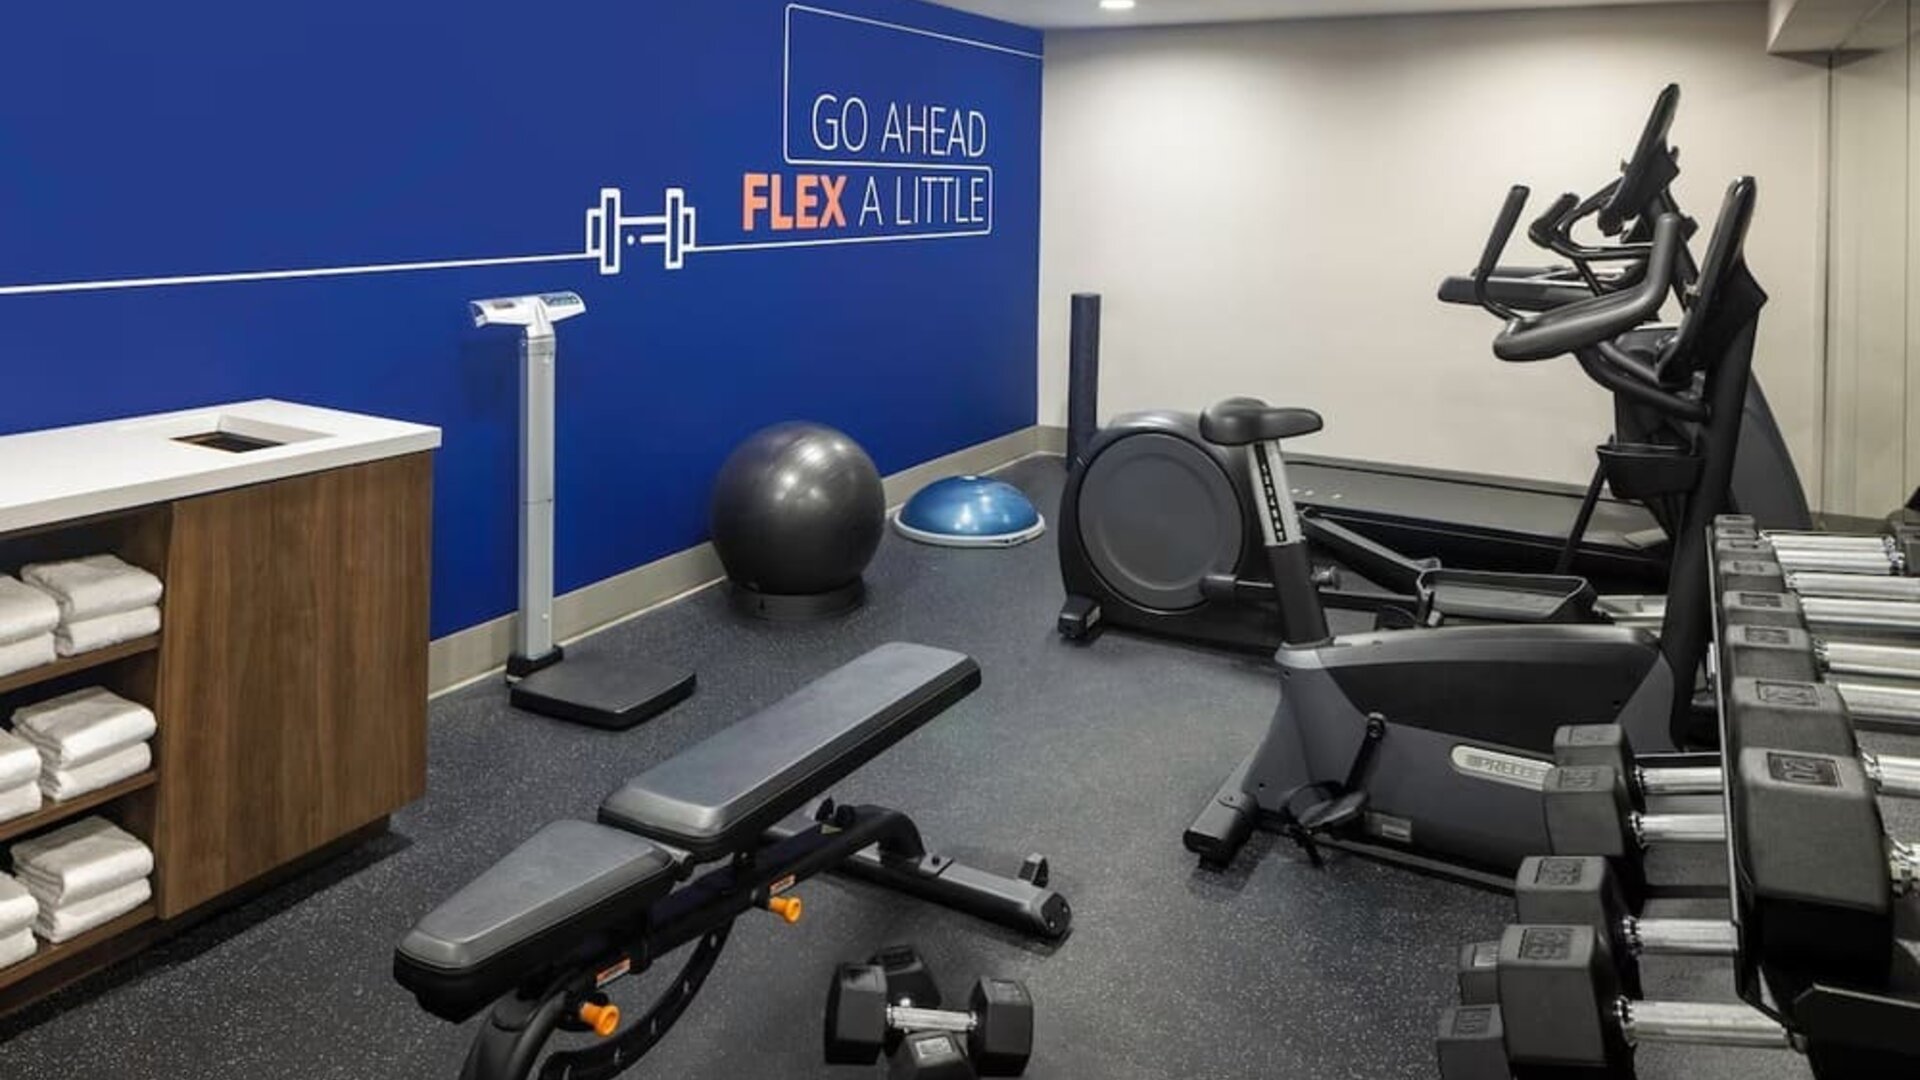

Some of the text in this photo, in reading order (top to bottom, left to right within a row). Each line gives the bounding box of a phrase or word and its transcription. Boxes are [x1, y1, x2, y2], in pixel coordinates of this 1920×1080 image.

[811, 94, 987, 158] GO AHEAD
[742, 172, 985, 231] FLEX A LITTLE
